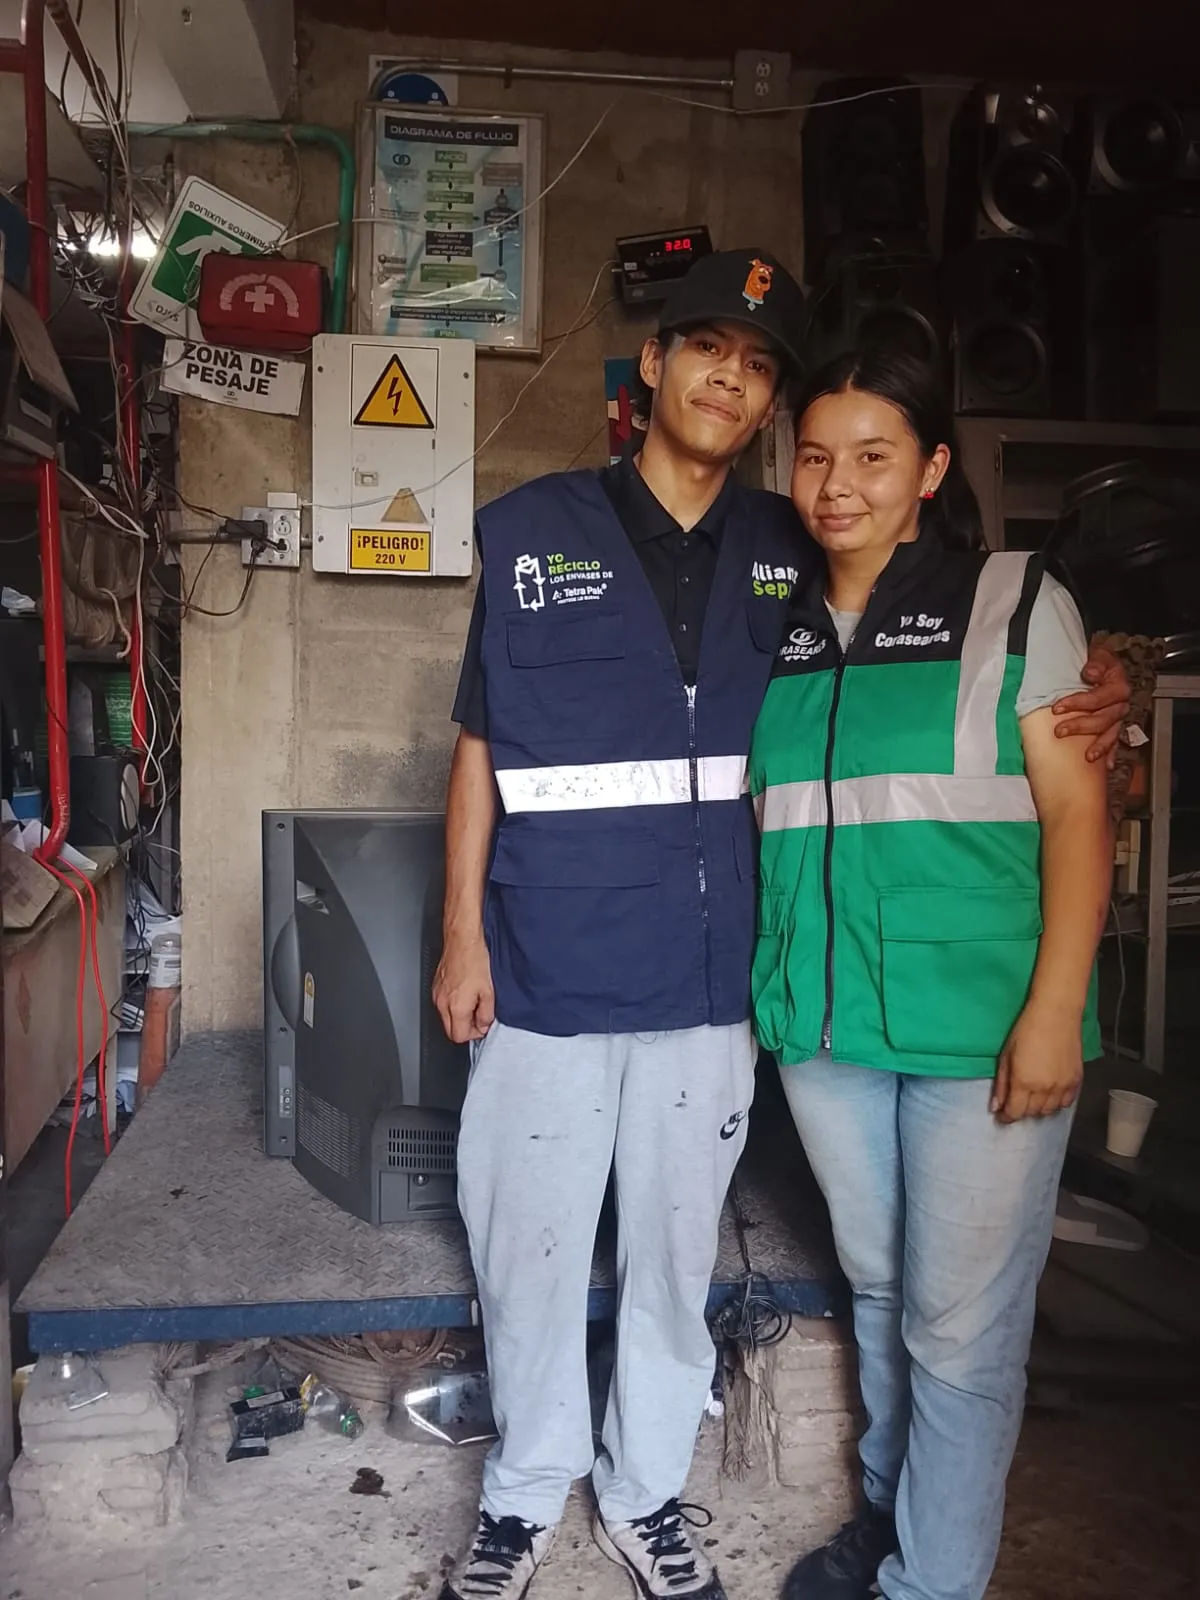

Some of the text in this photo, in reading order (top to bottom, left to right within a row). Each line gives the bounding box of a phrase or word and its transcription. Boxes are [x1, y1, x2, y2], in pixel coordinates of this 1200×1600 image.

[390, 125, 513, 141] DIAGRAMA DE FLUJO
[188, 200, 228, 228] AUXILIOS
[182, 342, 279, 378] ZONA DE
[185, 362, 271, 396] PESAJE
[357, 535, 424, 551] ¡PELIGRO!
[375, 553, 406, 565] 220 V
[546, 553, 564, 564] YO
[548, 560, 601, 576] RECICLO
[549, 571, 614, 585] LOS ENVASES DE
[563, 587, 586, 598] Tetra
[752, 580, 790, 600] Sep
[916, 613, 944, 631] Soy
